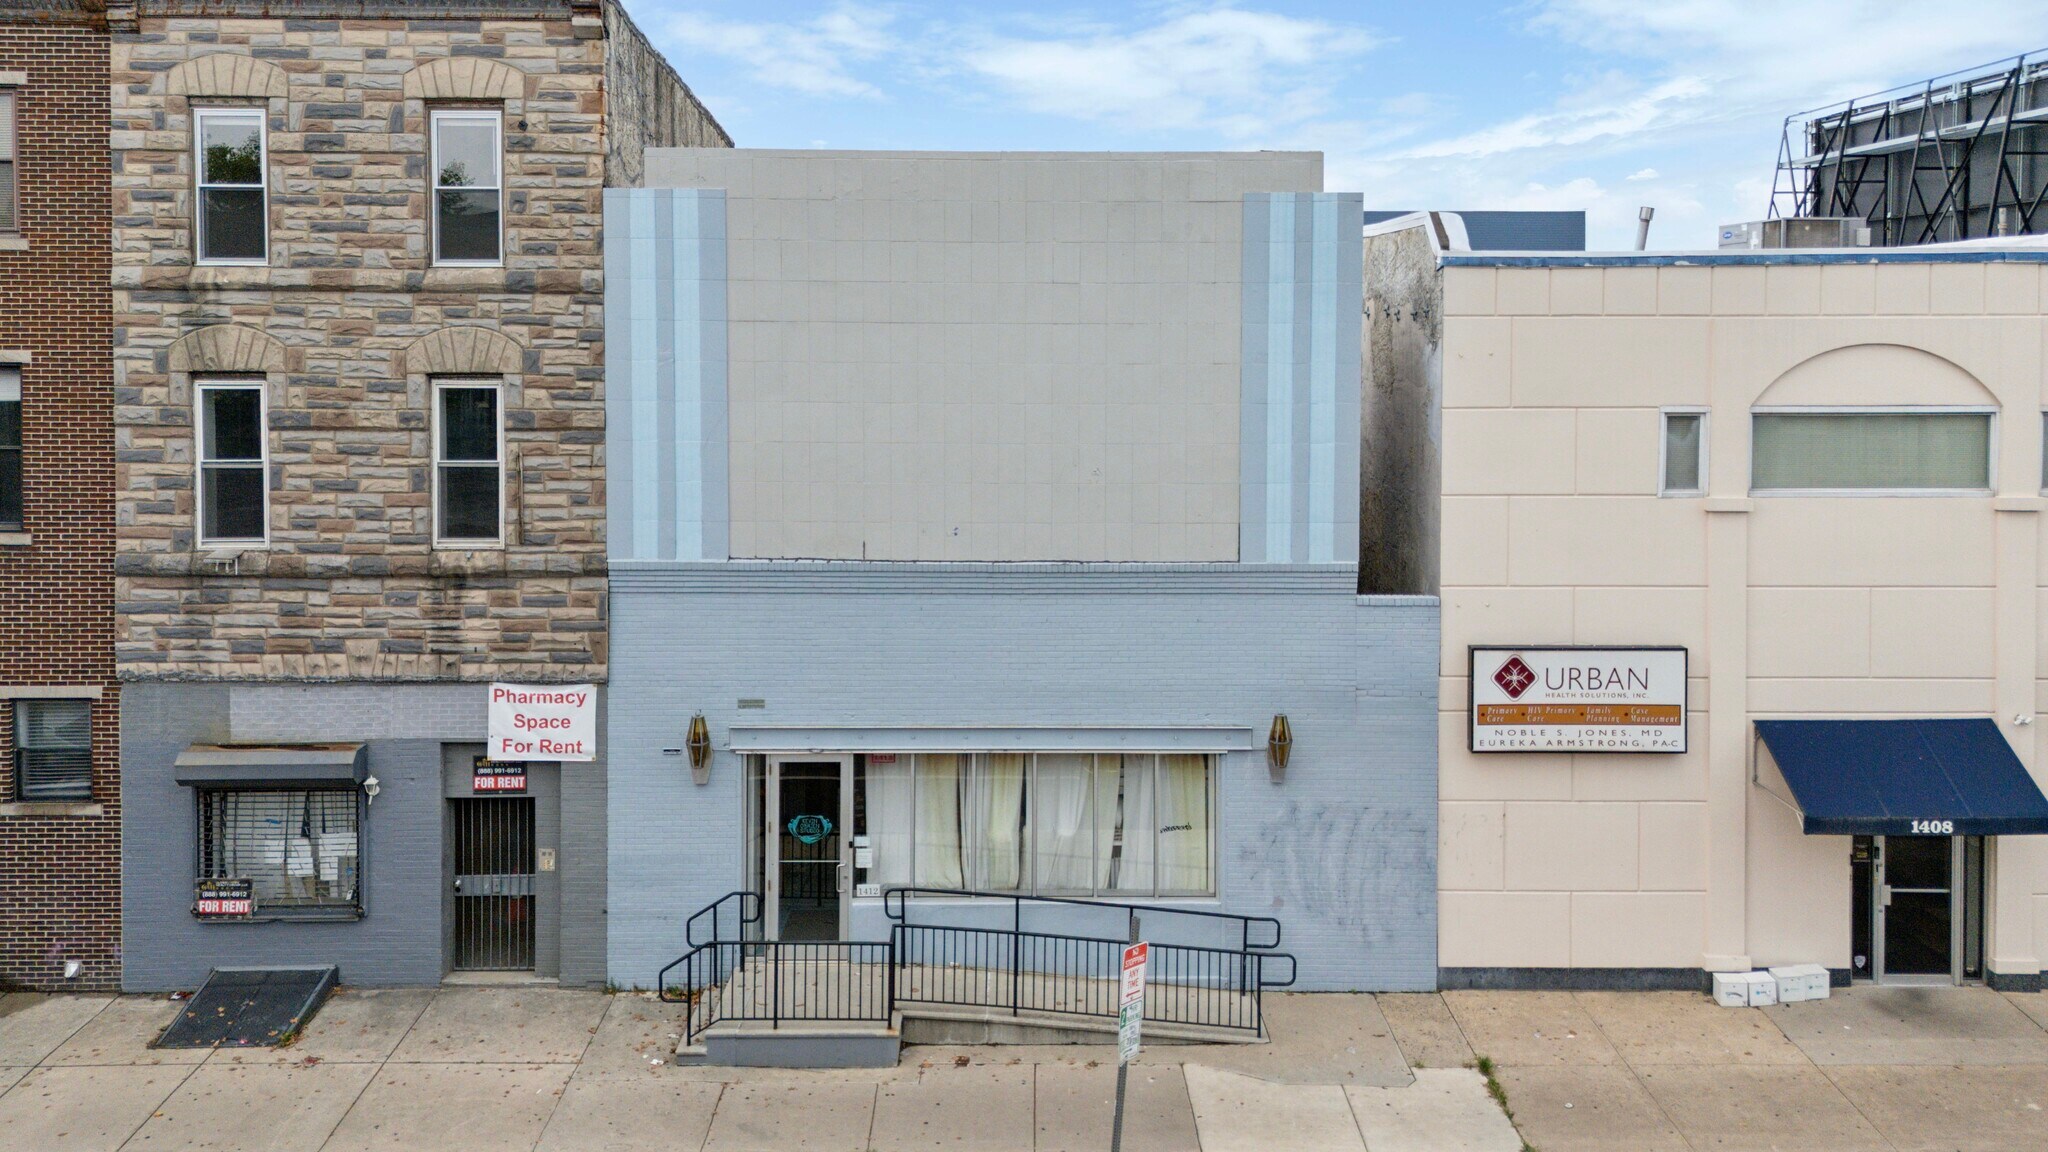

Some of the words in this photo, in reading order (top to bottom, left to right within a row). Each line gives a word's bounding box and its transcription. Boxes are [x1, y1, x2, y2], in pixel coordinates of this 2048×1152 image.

[1545, 667, 1648, 690] URBAN
[493, 688, 587, 707] Pharmacy
[1487, 706, 1518, 714] Primary
[1527, 706, 1541, 714] HIV
[1545, 706, 1576, 714] Primary
[1586, 706, 1611, 714] Family
[513, 713, 571, 732] Space
[1486, 714, 1504, 723] Care
[1527, 714, 1544, 722] Care
[1586, 714, 1620, 723] Planning
[1630, 714, 1678, 723] Management
[502, 738, 533, 753] For
[539, 738, 583, 754] Rent
[474, 776, 495, 789] FOR
[497, 776, 525, 788] RENT
[1911, 820, 1954, 834] 1408
[858, 887, 879, 895] 1412
[199, 900, 219, 913] FOR
[222, 900, 250, 912] RENT
[1132, 947, 1140, 956] NO
[1124, 954, 1145, 967] STOPPING
[1128, 968, 1139, 979] ANY
[1128, 978, 1139, 989] TIME
